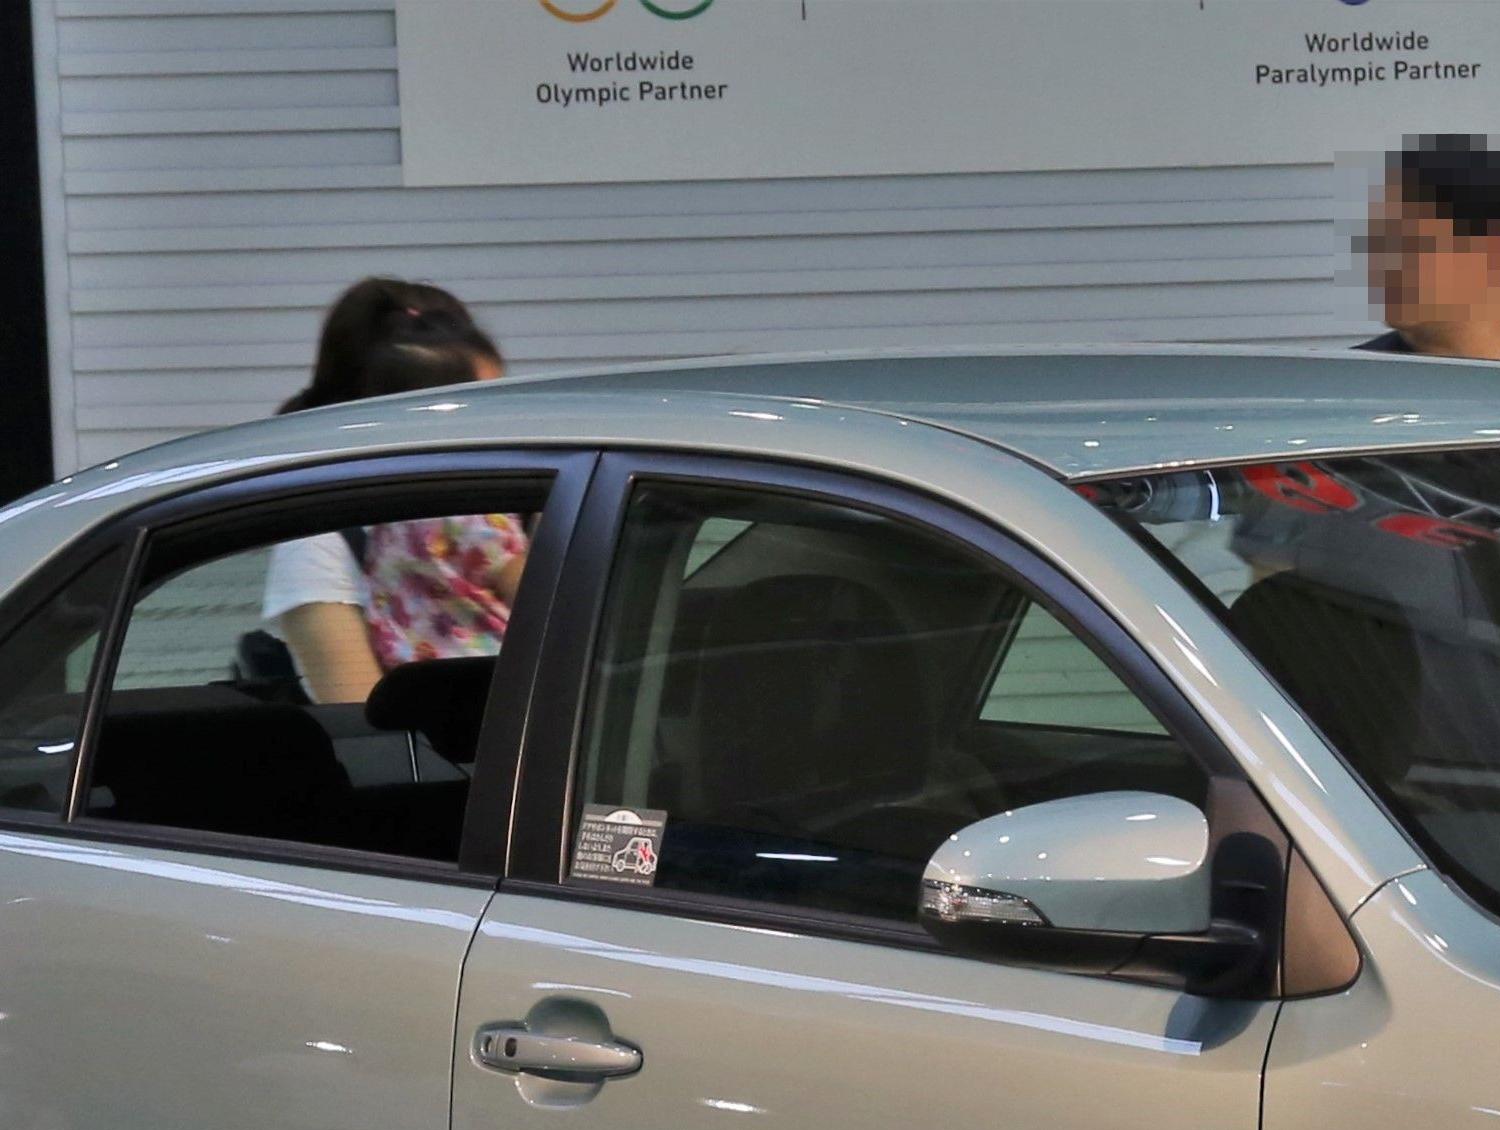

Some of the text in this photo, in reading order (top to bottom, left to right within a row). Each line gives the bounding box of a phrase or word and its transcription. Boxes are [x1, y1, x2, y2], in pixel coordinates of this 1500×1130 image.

[1304, 31, 1430, 53] Worldwide
[566, 51, 695, 73] Worldwide
[1255, 60, 1482, 87] Paralympic Partner
[536, 80, 729, 108] Olympic Partner
